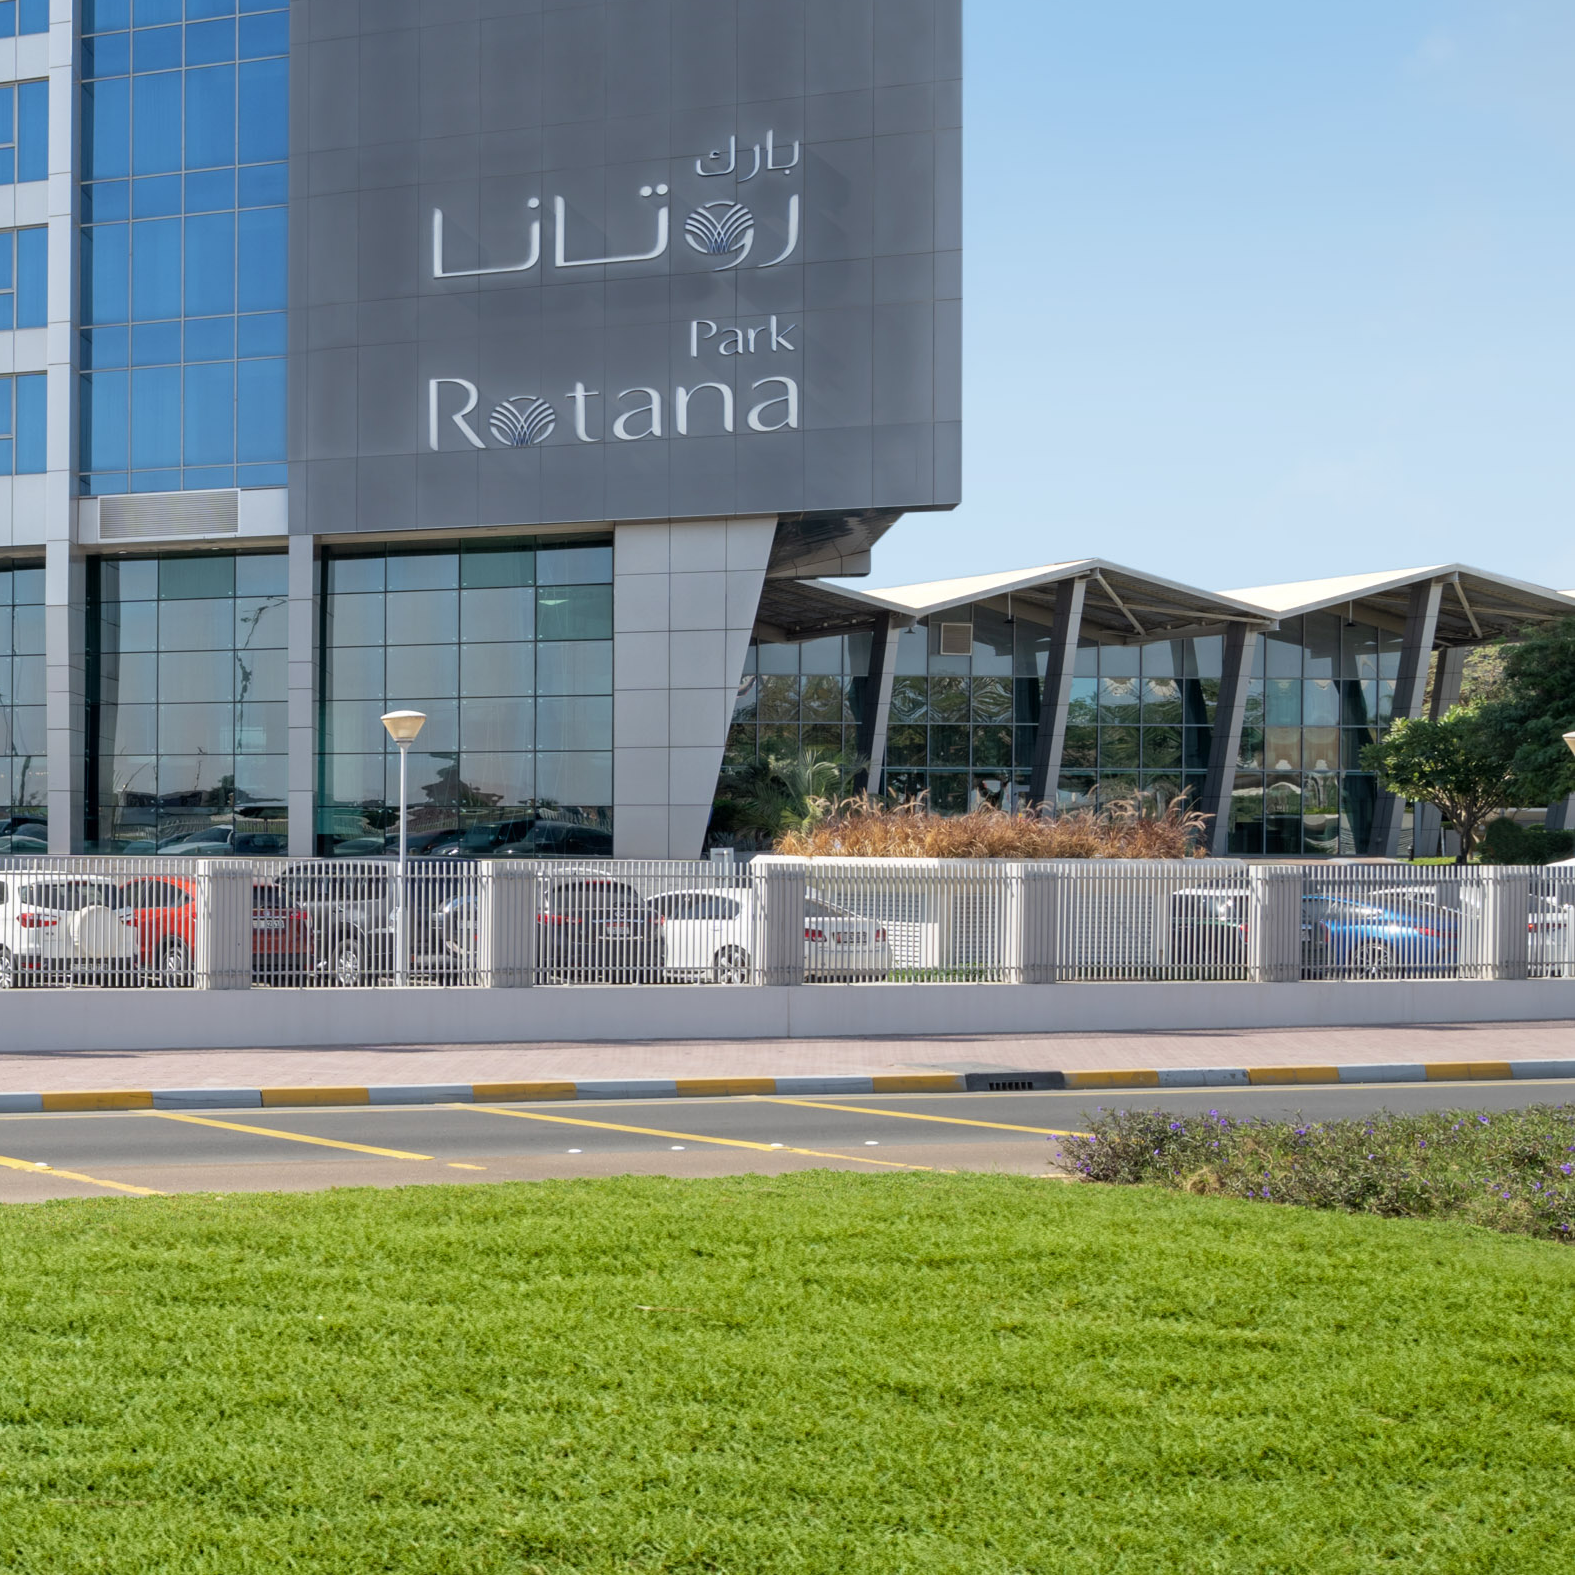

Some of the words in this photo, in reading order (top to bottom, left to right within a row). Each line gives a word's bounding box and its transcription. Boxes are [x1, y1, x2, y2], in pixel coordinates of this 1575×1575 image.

[695, 129, 800, 183] بارك
[433, 183, 799, 279] روتانا
[690, 315, 797, 358] Park
[429, 376, 799, 451] Rotana
